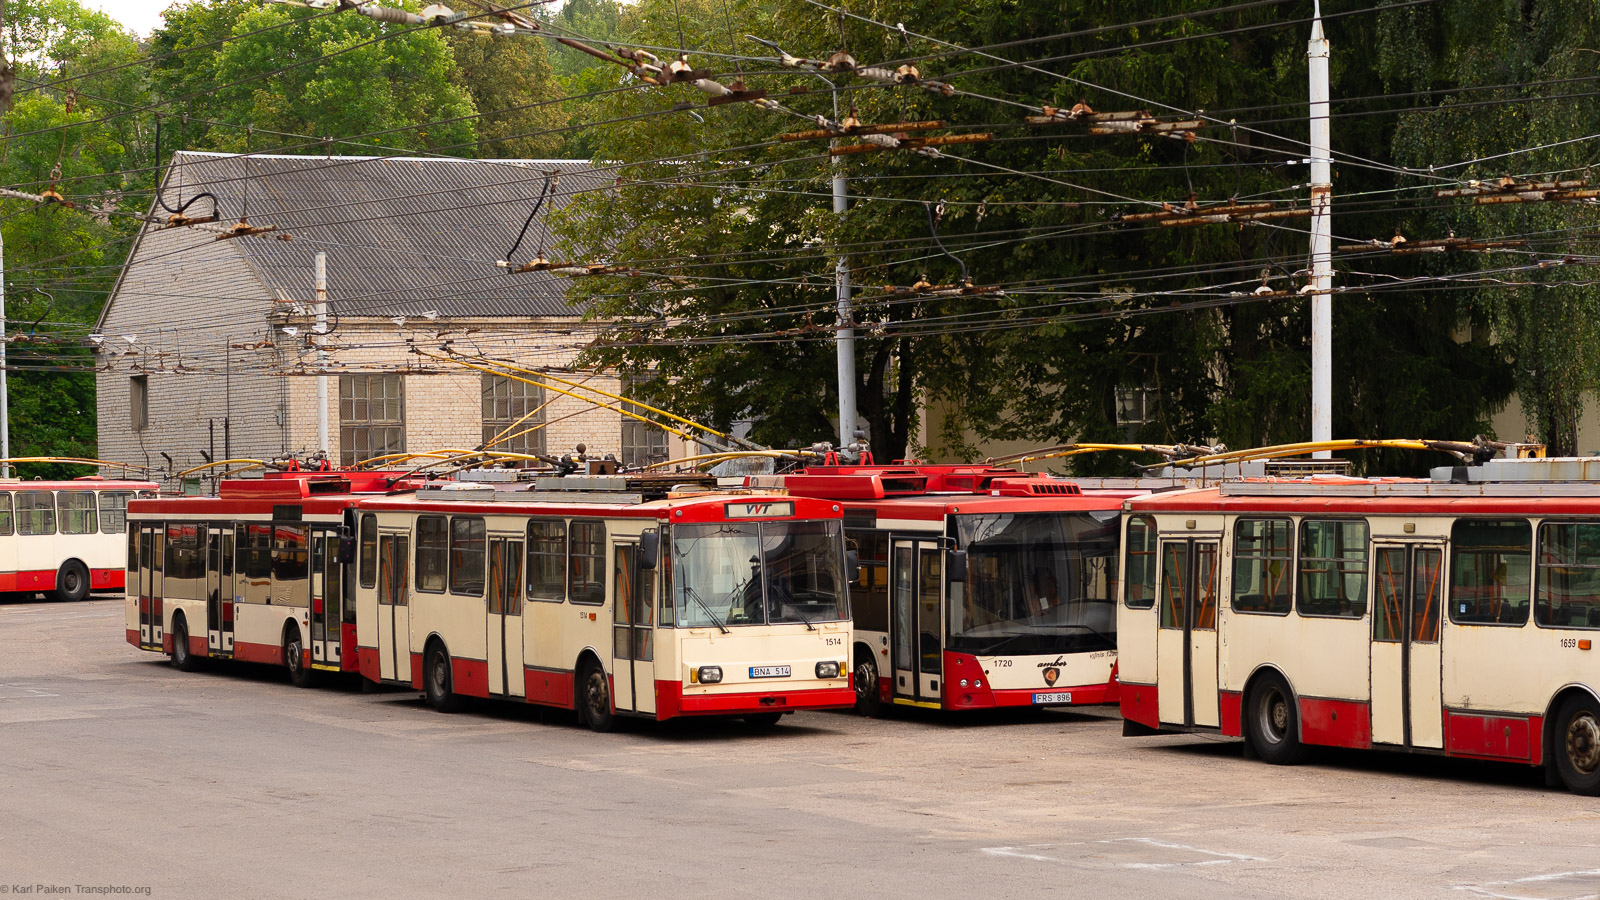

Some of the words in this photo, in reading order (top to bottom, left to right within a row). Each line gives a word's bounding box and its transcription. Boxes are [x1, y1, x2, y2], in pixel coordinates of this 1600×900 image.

[746, 503, 772, 515] VVT
[825, 638, 842, 646] 1514
[1560, 638, 1576, 648] 1659
[1037, 655, 1067, 667] amber
[754, 668, 771, 676] BNA
[775, 667, 789, 675] 514
[1036, 694, 1053, 702] FRS
[1056, 693, 1071, 702] 896
